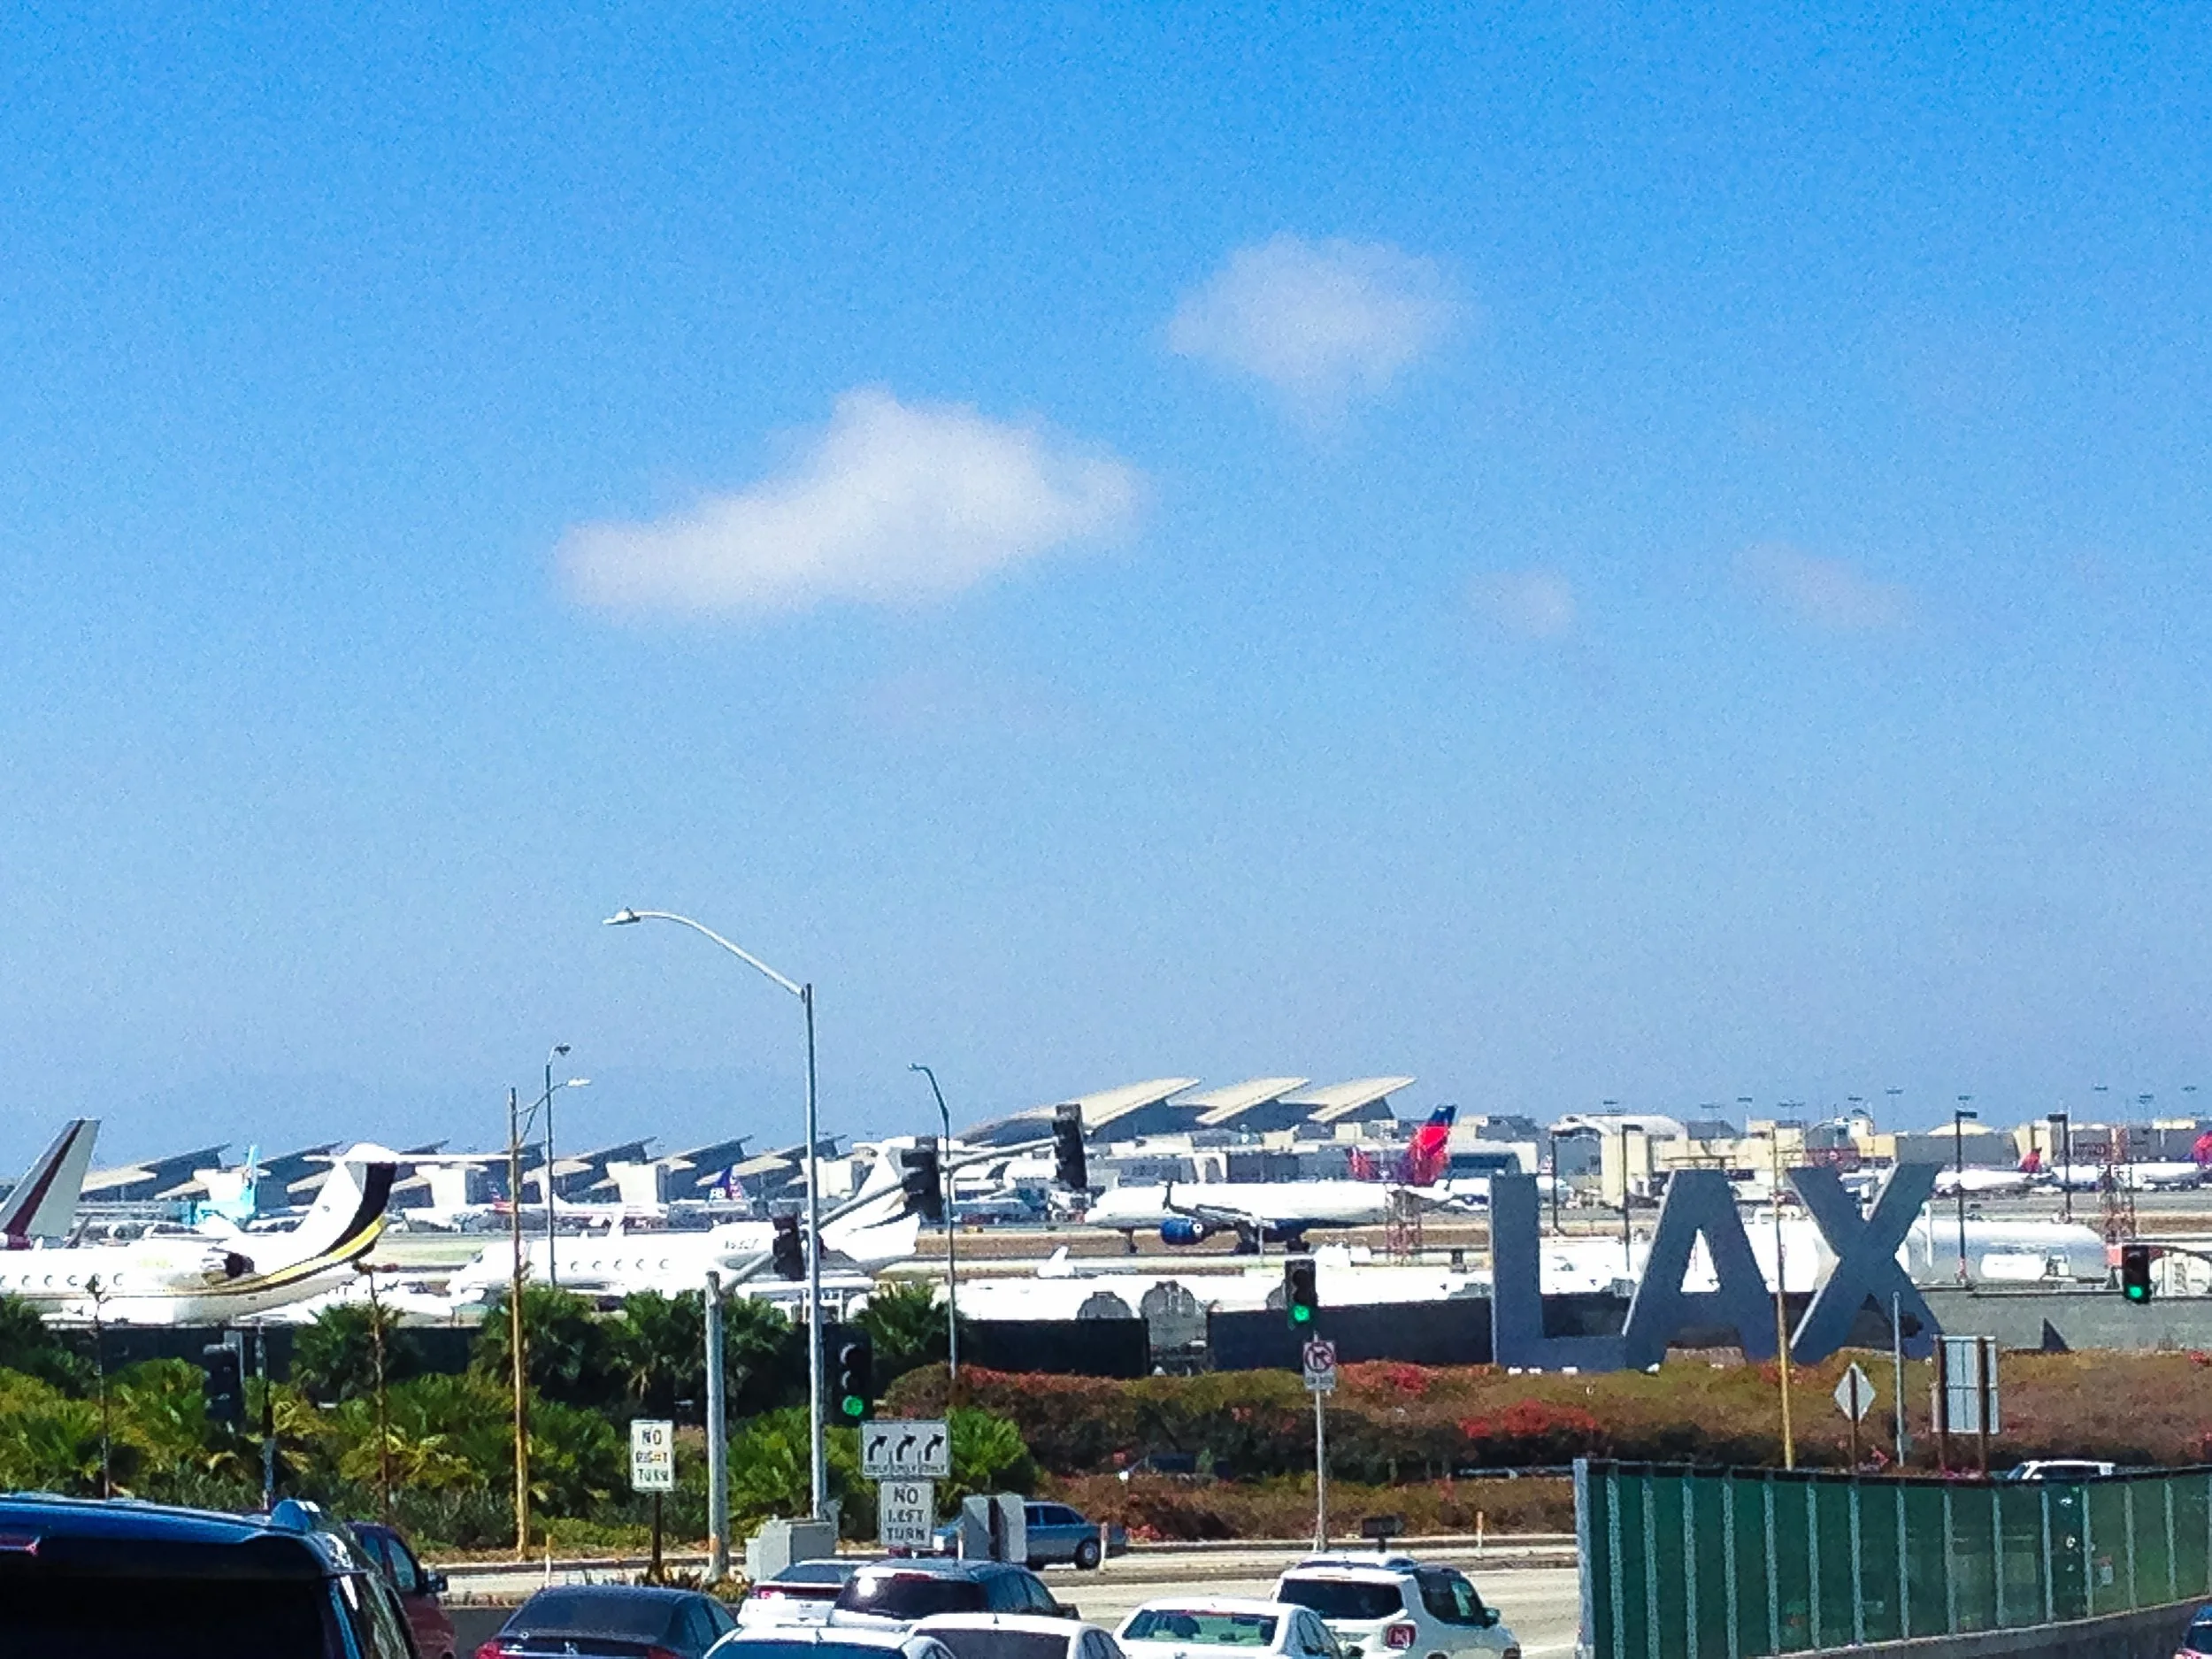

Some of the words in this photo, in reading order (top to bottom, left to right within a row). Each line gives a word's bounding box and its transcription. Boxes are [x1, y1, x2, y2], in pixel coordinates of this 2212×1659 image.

[1490, 1162, 1944, 1372] LAX
[642, 1429, 662, 1445] NO
[638, 1469, 669, 1481] TURN
[894, 1486, 919, 1504] NO
[887, 1509, 925, 1522] LEFT
[887, 1527, 926, 1540] TURN
